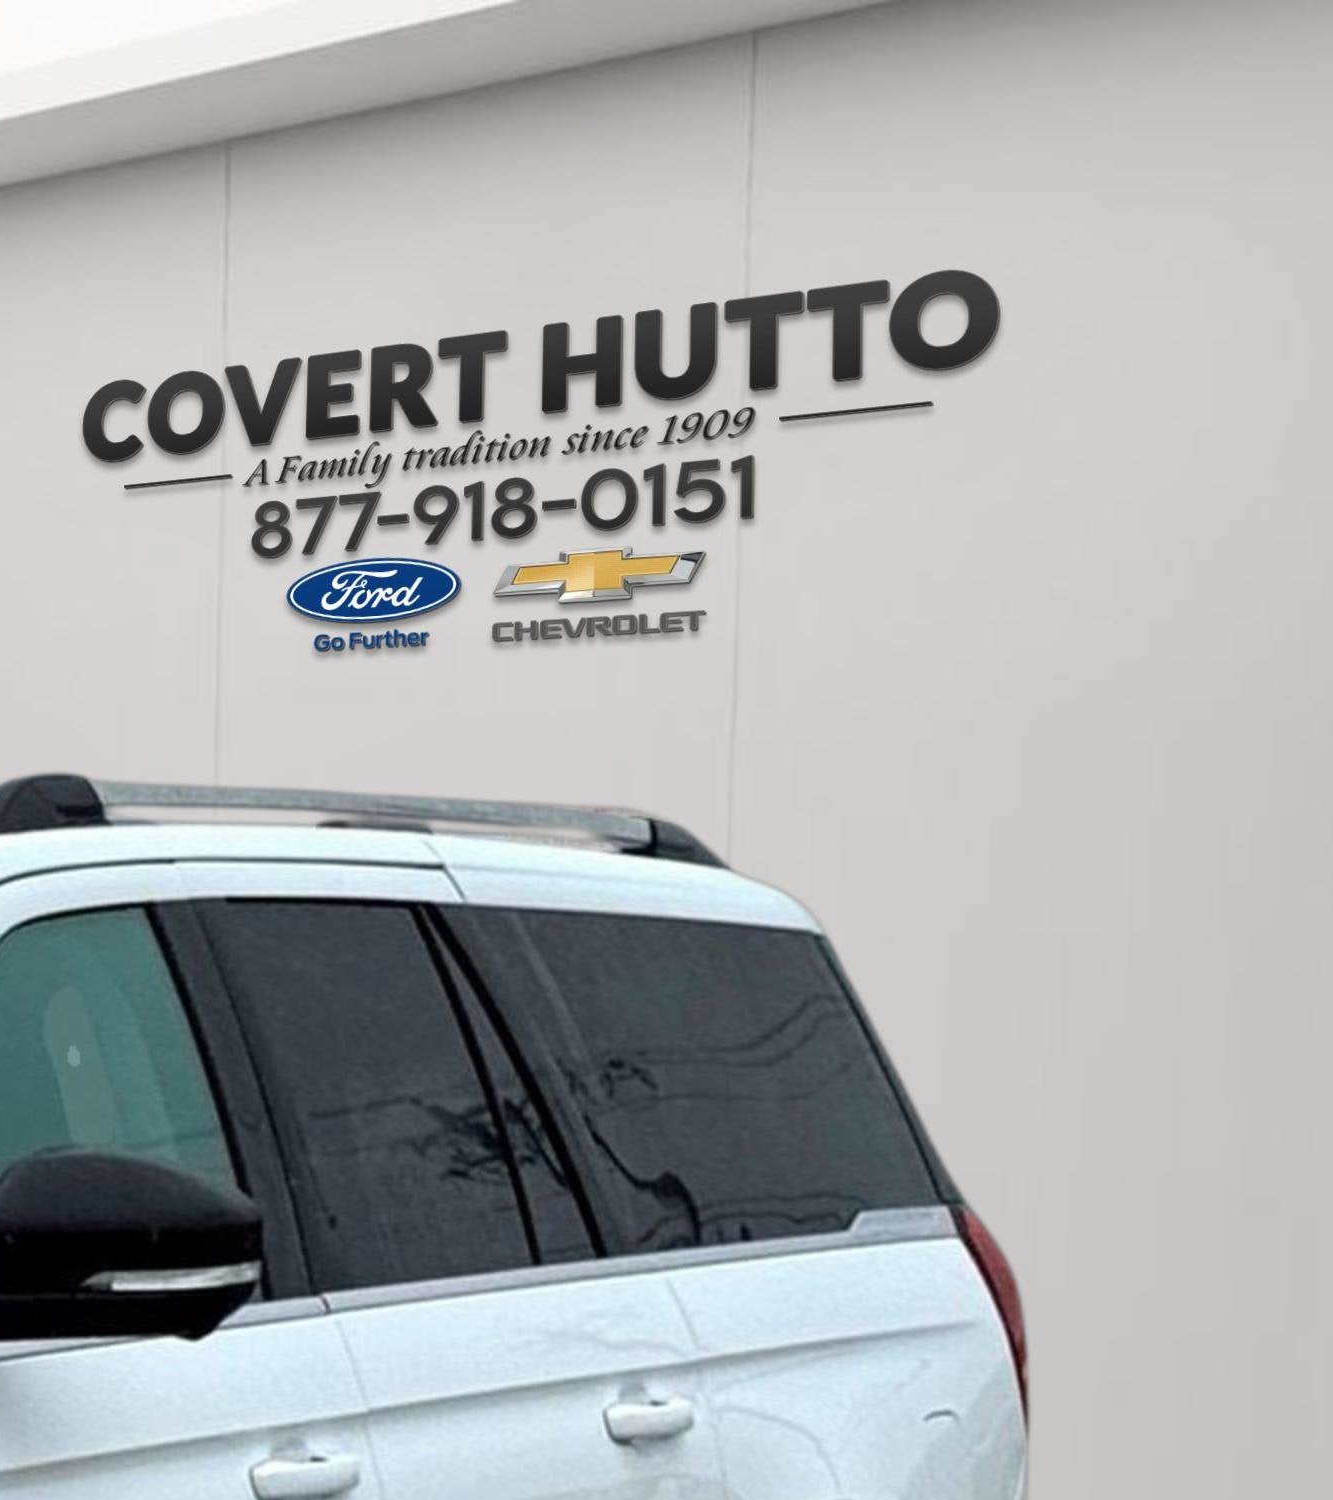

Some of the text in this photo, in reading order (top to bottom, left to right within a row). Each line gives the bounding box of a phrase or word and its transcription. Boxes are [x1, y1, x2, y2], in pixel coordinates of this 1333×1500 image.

[81, 269, 1001, 462] COVERT HUTTO
[242, 406, 756, 489] A Family tradition since 1909
[251, 455, 755, 559] 877-918-0151
[320, 568, 423, 611] Ford
[313, 628, 430, 653] Go Further
[491, 609, 707, 644] CHEVROLET
